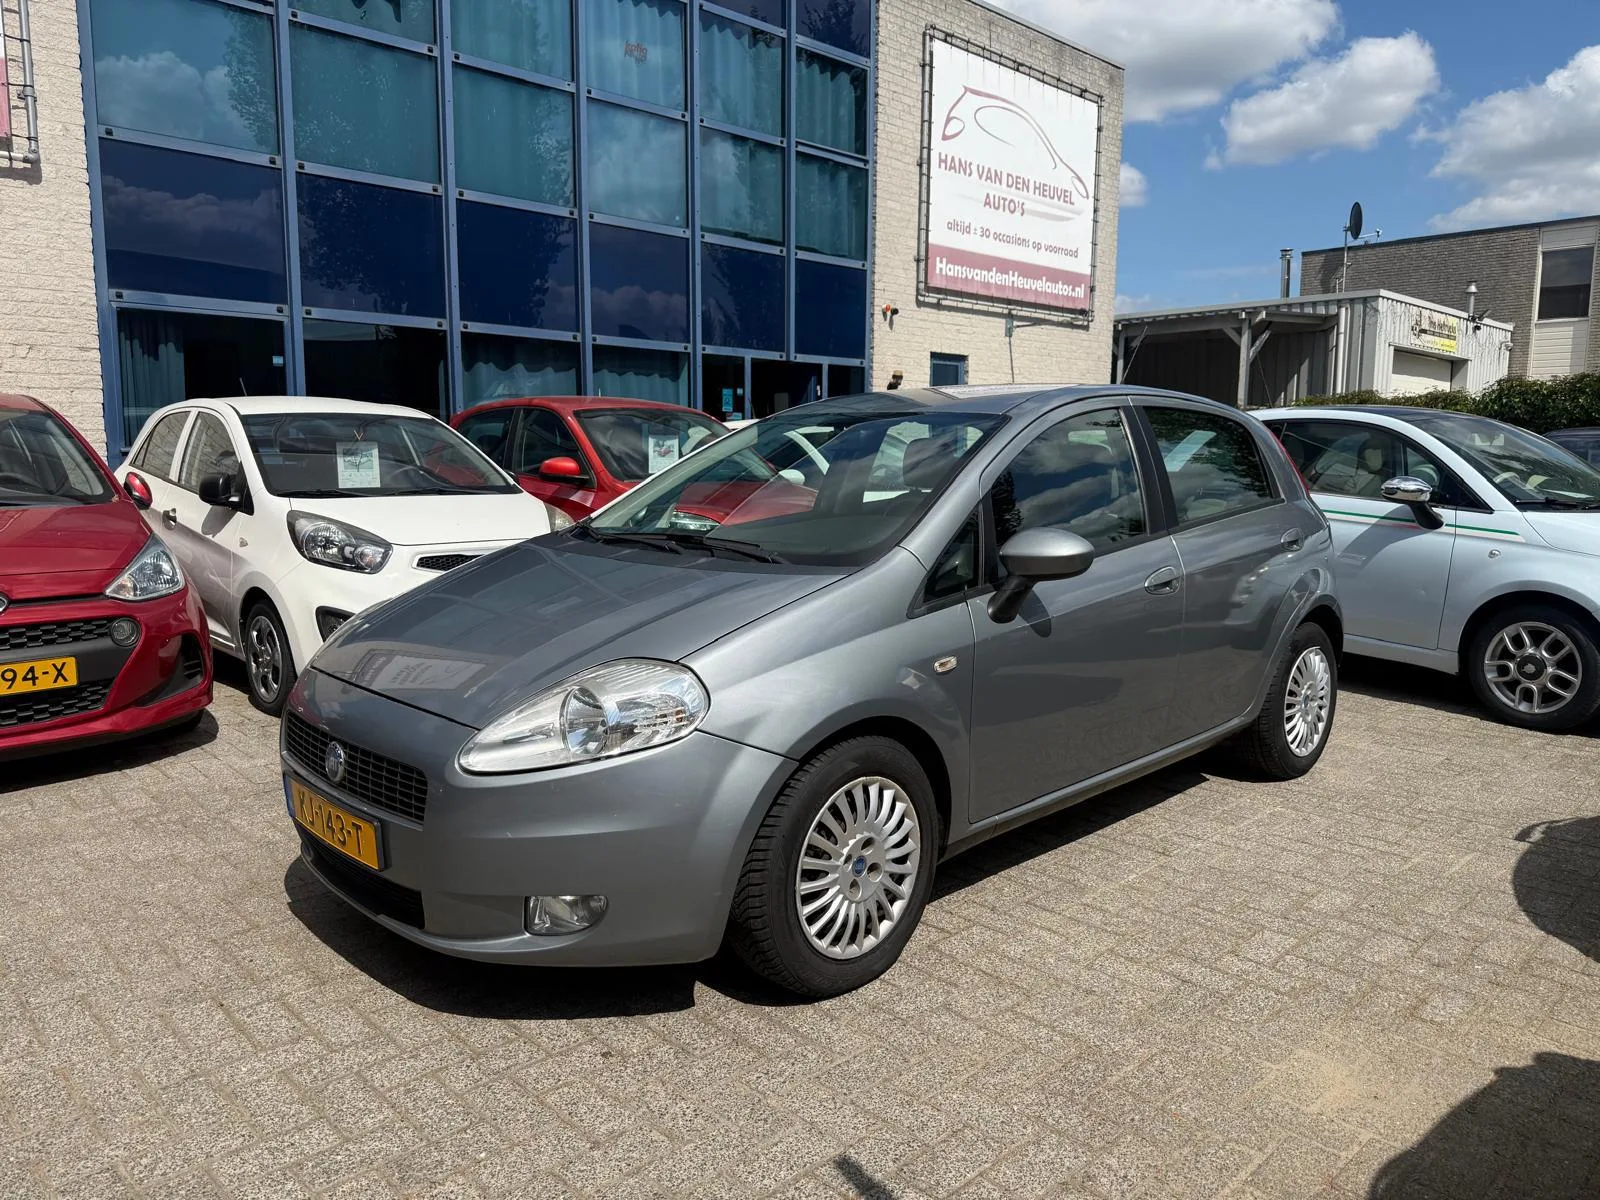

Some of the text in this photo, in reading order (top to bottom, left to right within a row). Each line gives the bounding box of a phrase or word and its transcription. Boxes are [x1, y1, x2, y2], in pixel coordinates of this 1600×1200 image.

[938, 152, 1075, 206] HANS VAN DEN HEUVEL
[983, 192, 1025, 216] AUTO'S
[946, 219, 971, 236] altijd
[979, 226, 991, 239] 30
[992, 232, 1030, 249] occasions
[1031, 240, 1042, 253] op
[1043, 244, 1079, 259] voorraad
[935, 256, 1085, 298] HansvandenHeuvelautos.nl
[0, 661, 69, 690] 94-X
[297, 789, 365, 857] KJ-143-T
